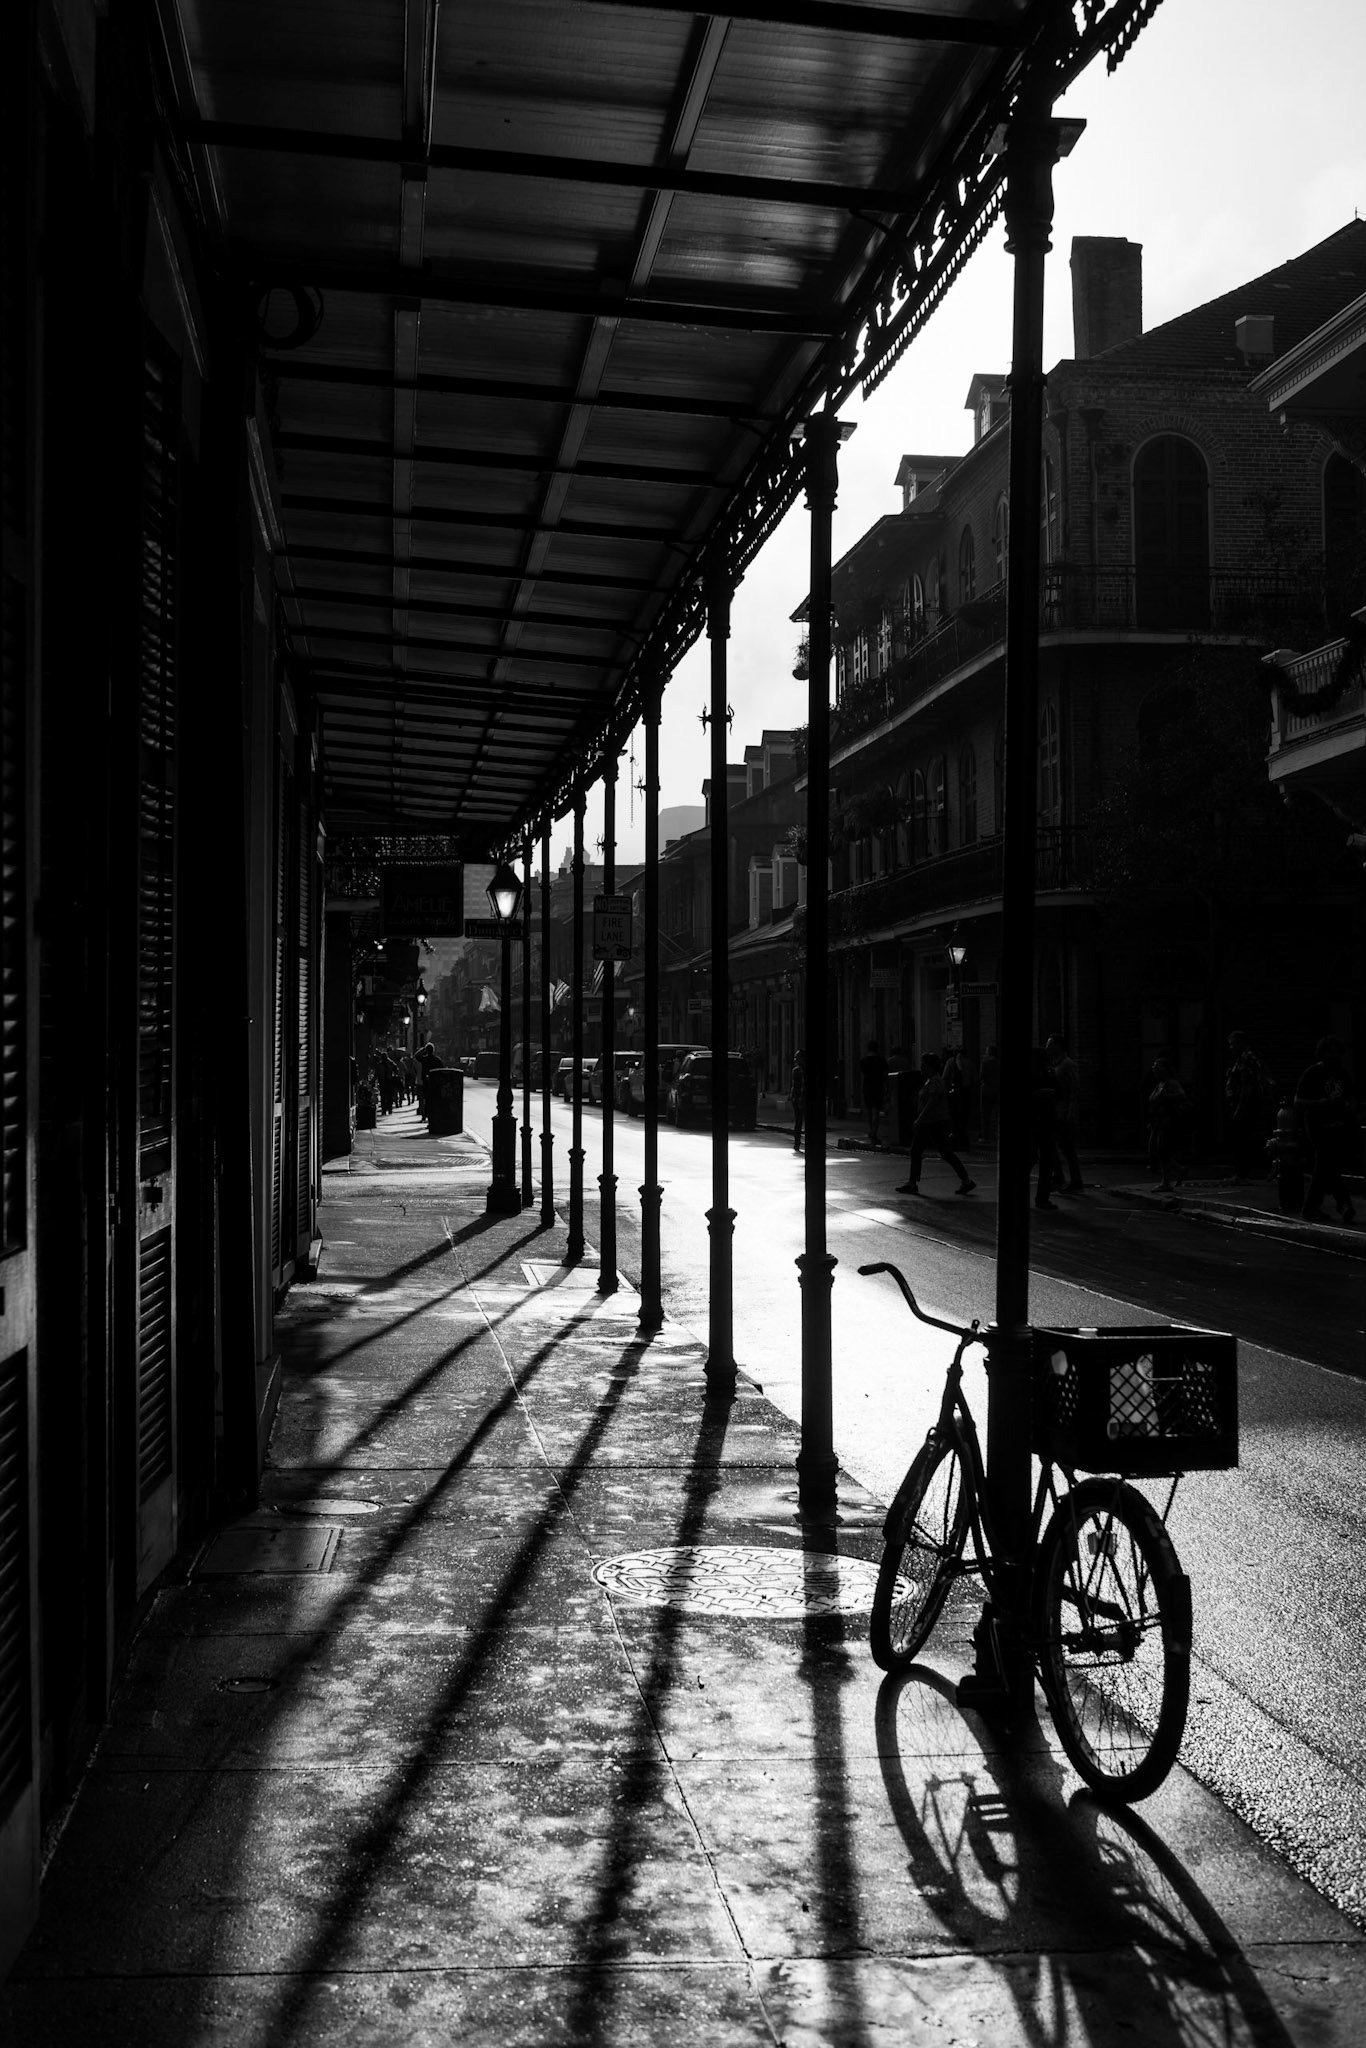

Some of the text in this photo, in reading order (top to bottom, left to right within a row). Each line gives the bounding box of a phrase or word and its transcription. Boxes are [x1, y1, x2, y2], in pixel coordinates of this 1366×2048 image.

[594, 897, 608, 913] NO
[602, 917, 625, 928] FIRE
[601, 931, 625, 942] LANE
